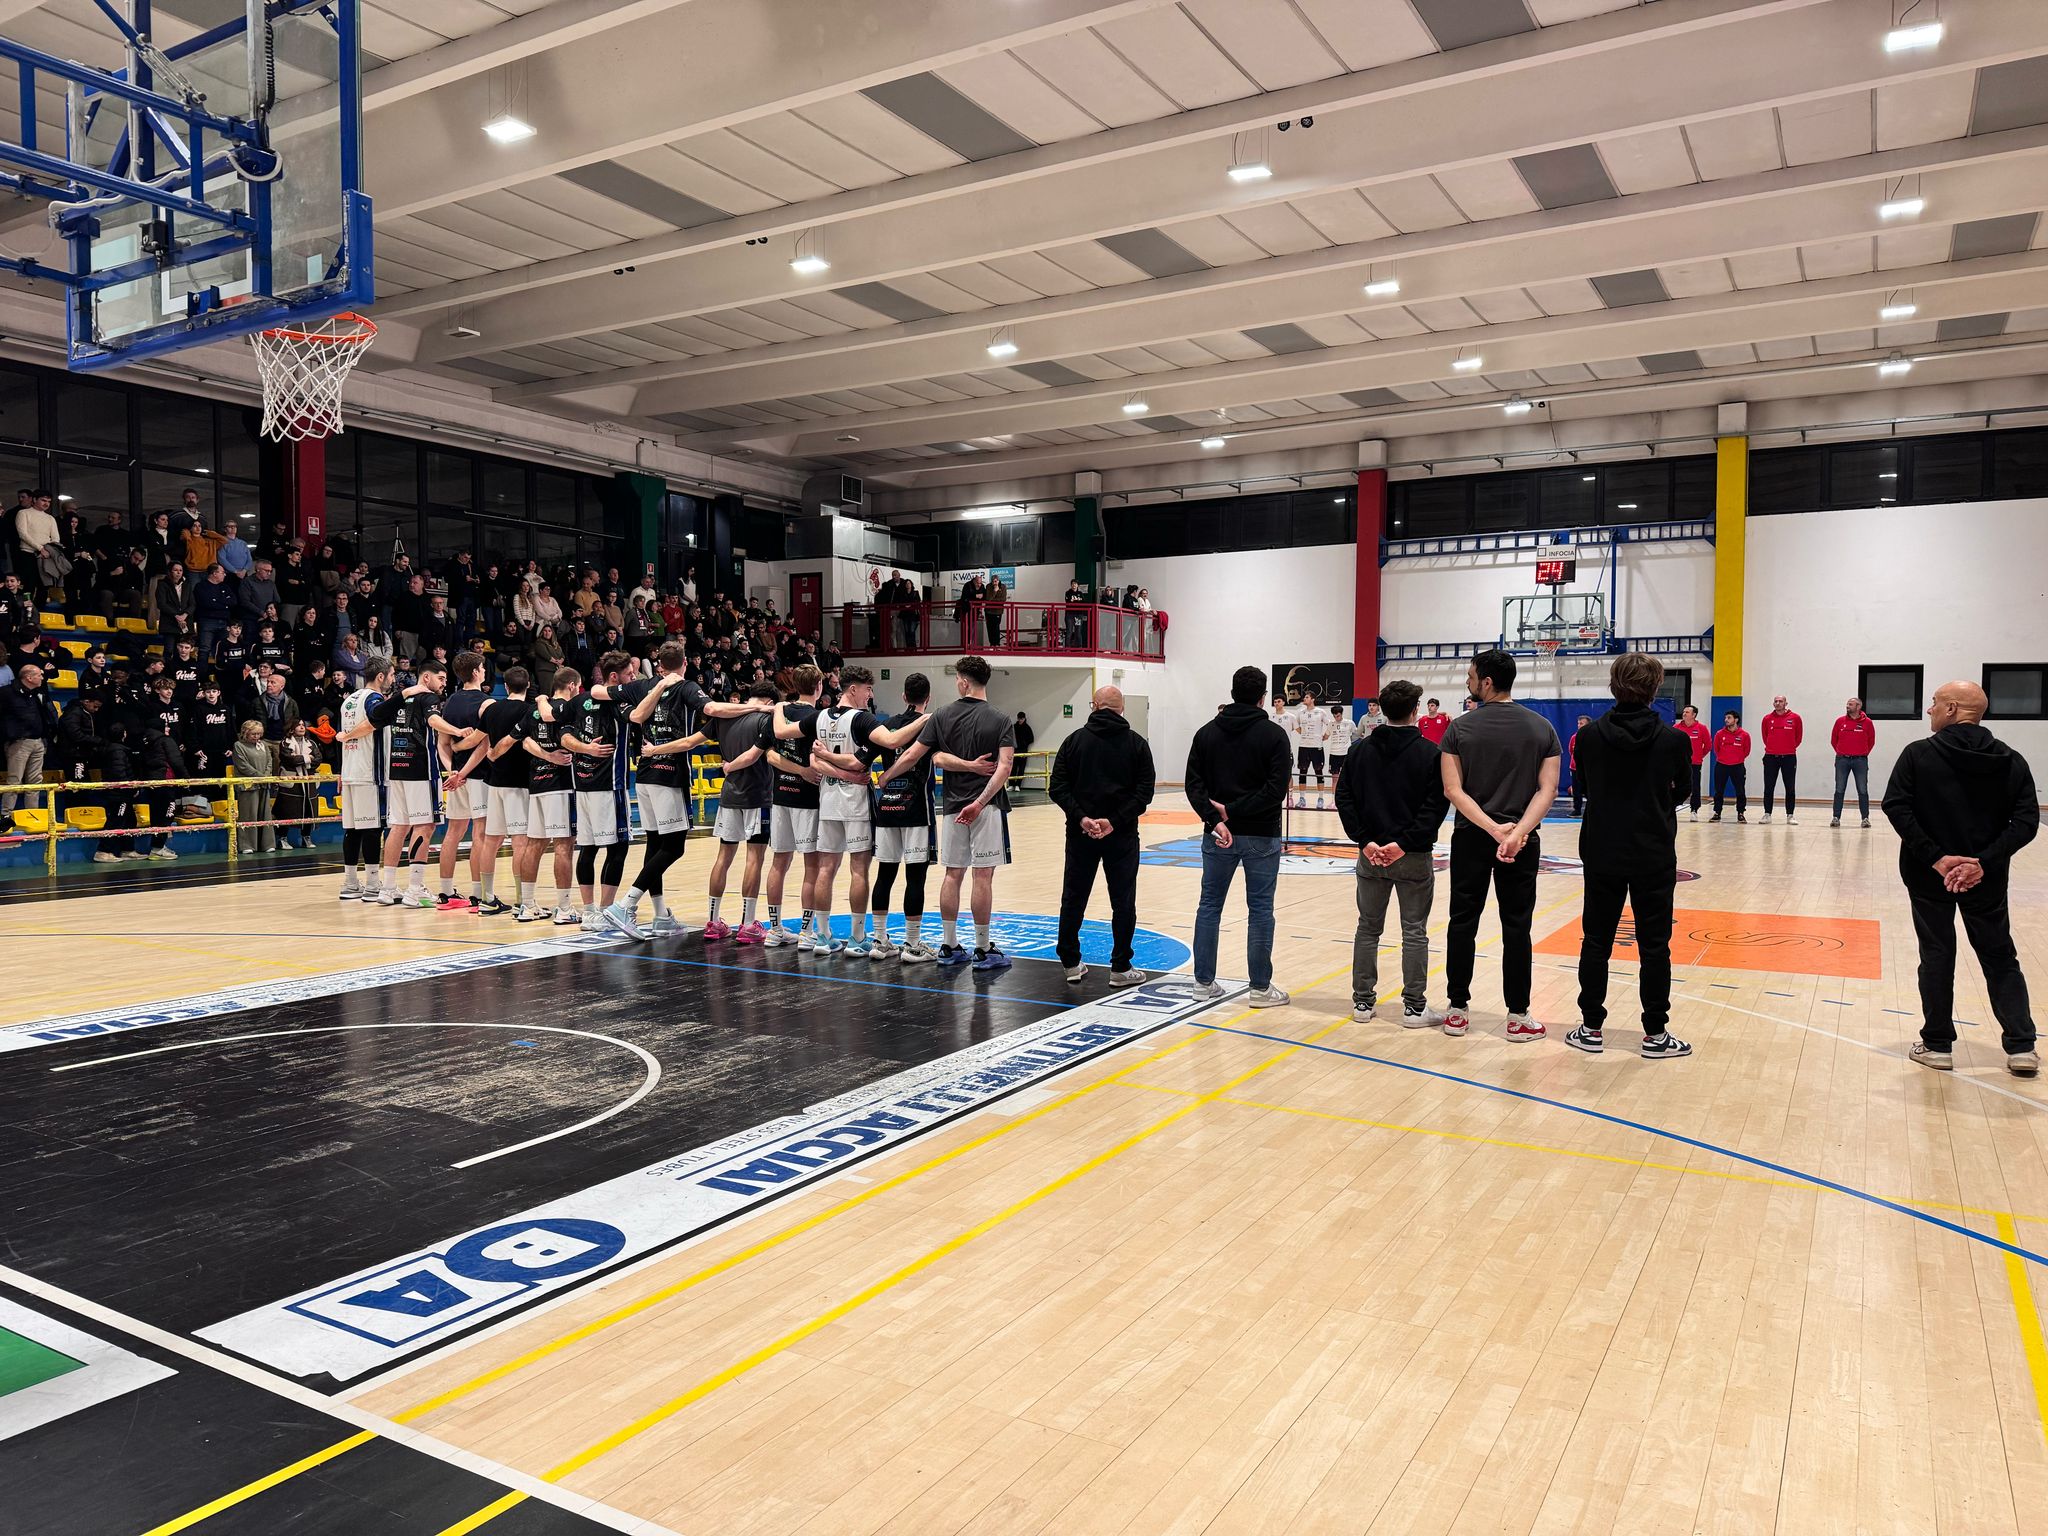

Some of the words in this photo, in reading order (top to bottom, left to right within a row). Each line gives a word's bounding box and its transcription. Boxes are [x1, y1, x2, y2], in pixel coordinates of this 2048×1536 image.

[1537, 562, 1564, 580] 24
[176, 670, 196, 680] Hub
[206, 713, 226, 724] Hub
[696, 1109, 921, 1196] ACCIAI
[711, 1131, 763, 1153] STEEL
[646, 1152, 704, 1178] TUBES
[339, 1227, 600, 1318] BA
